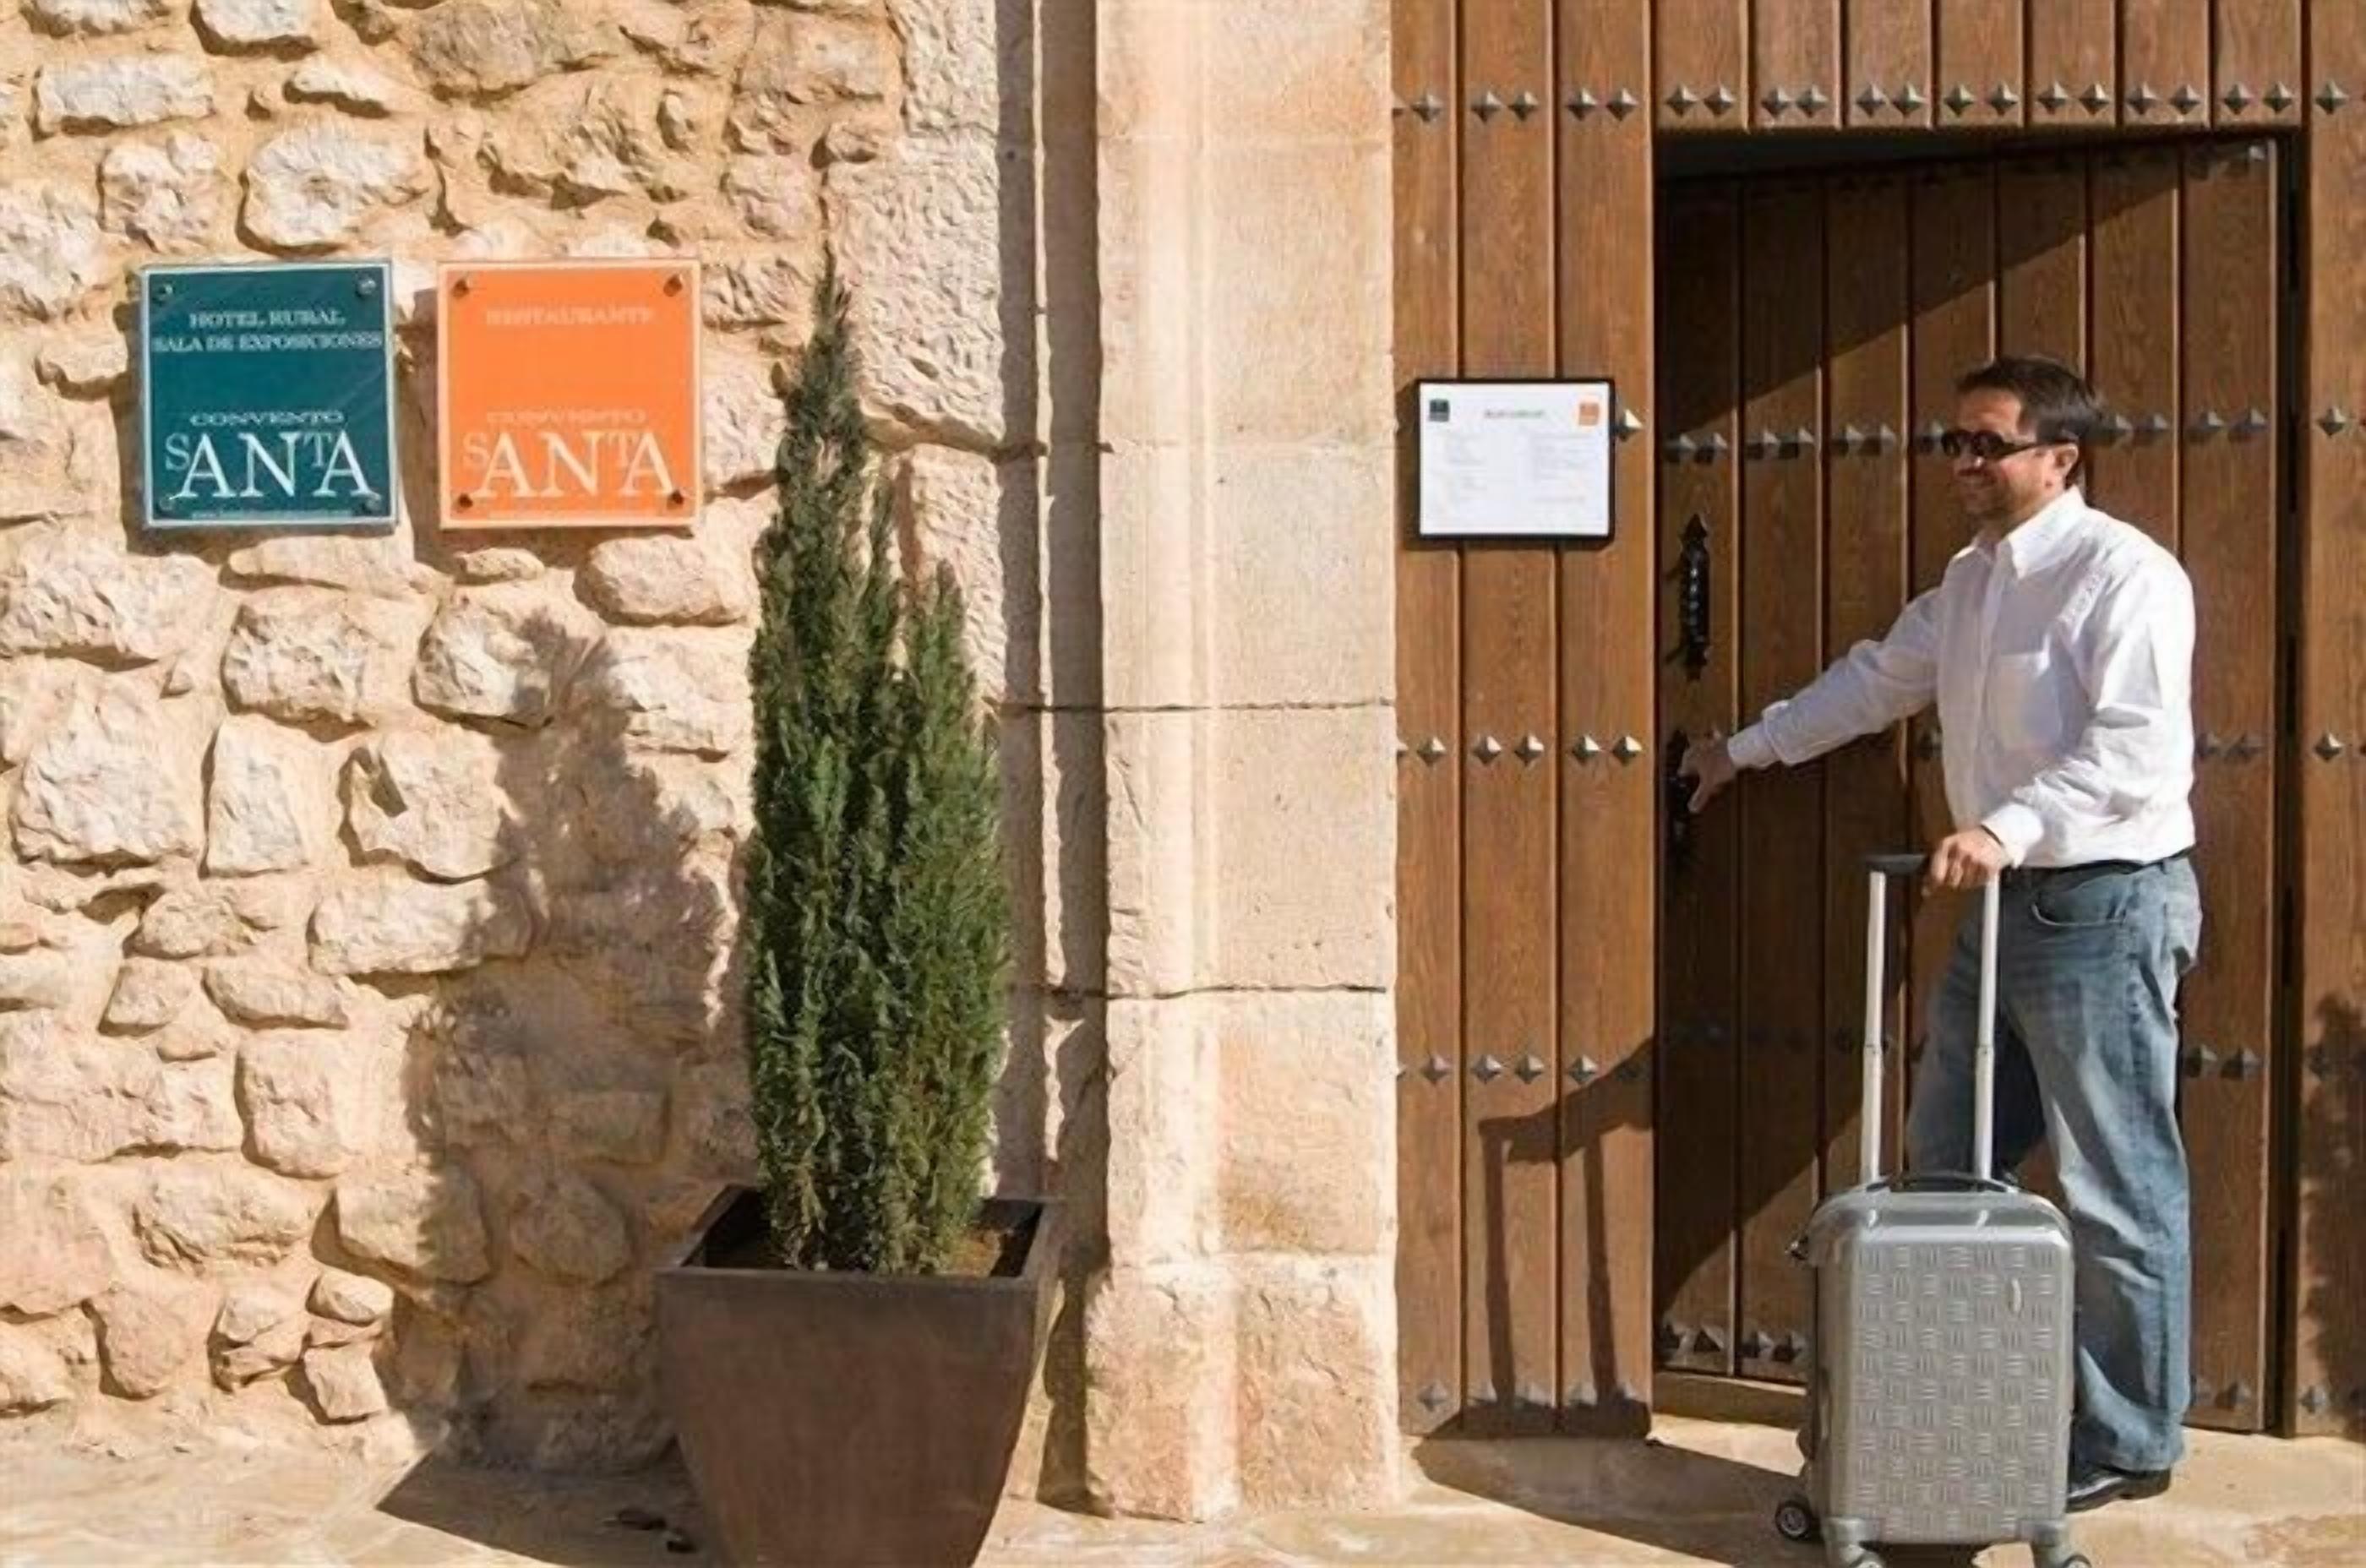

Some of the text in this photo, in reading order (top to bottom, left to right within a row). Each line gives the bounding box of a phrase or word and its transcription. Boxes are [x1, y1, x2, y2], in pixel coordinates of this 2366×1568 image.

[189, 308, 346, 329] HOTEL RURAL
[205, 334, 234, 351] DE
[189, 410, 344, 427] CONVENTO
[166, 430, 379, 498] SANTA
[462, 431, 675, 498] SANTA
